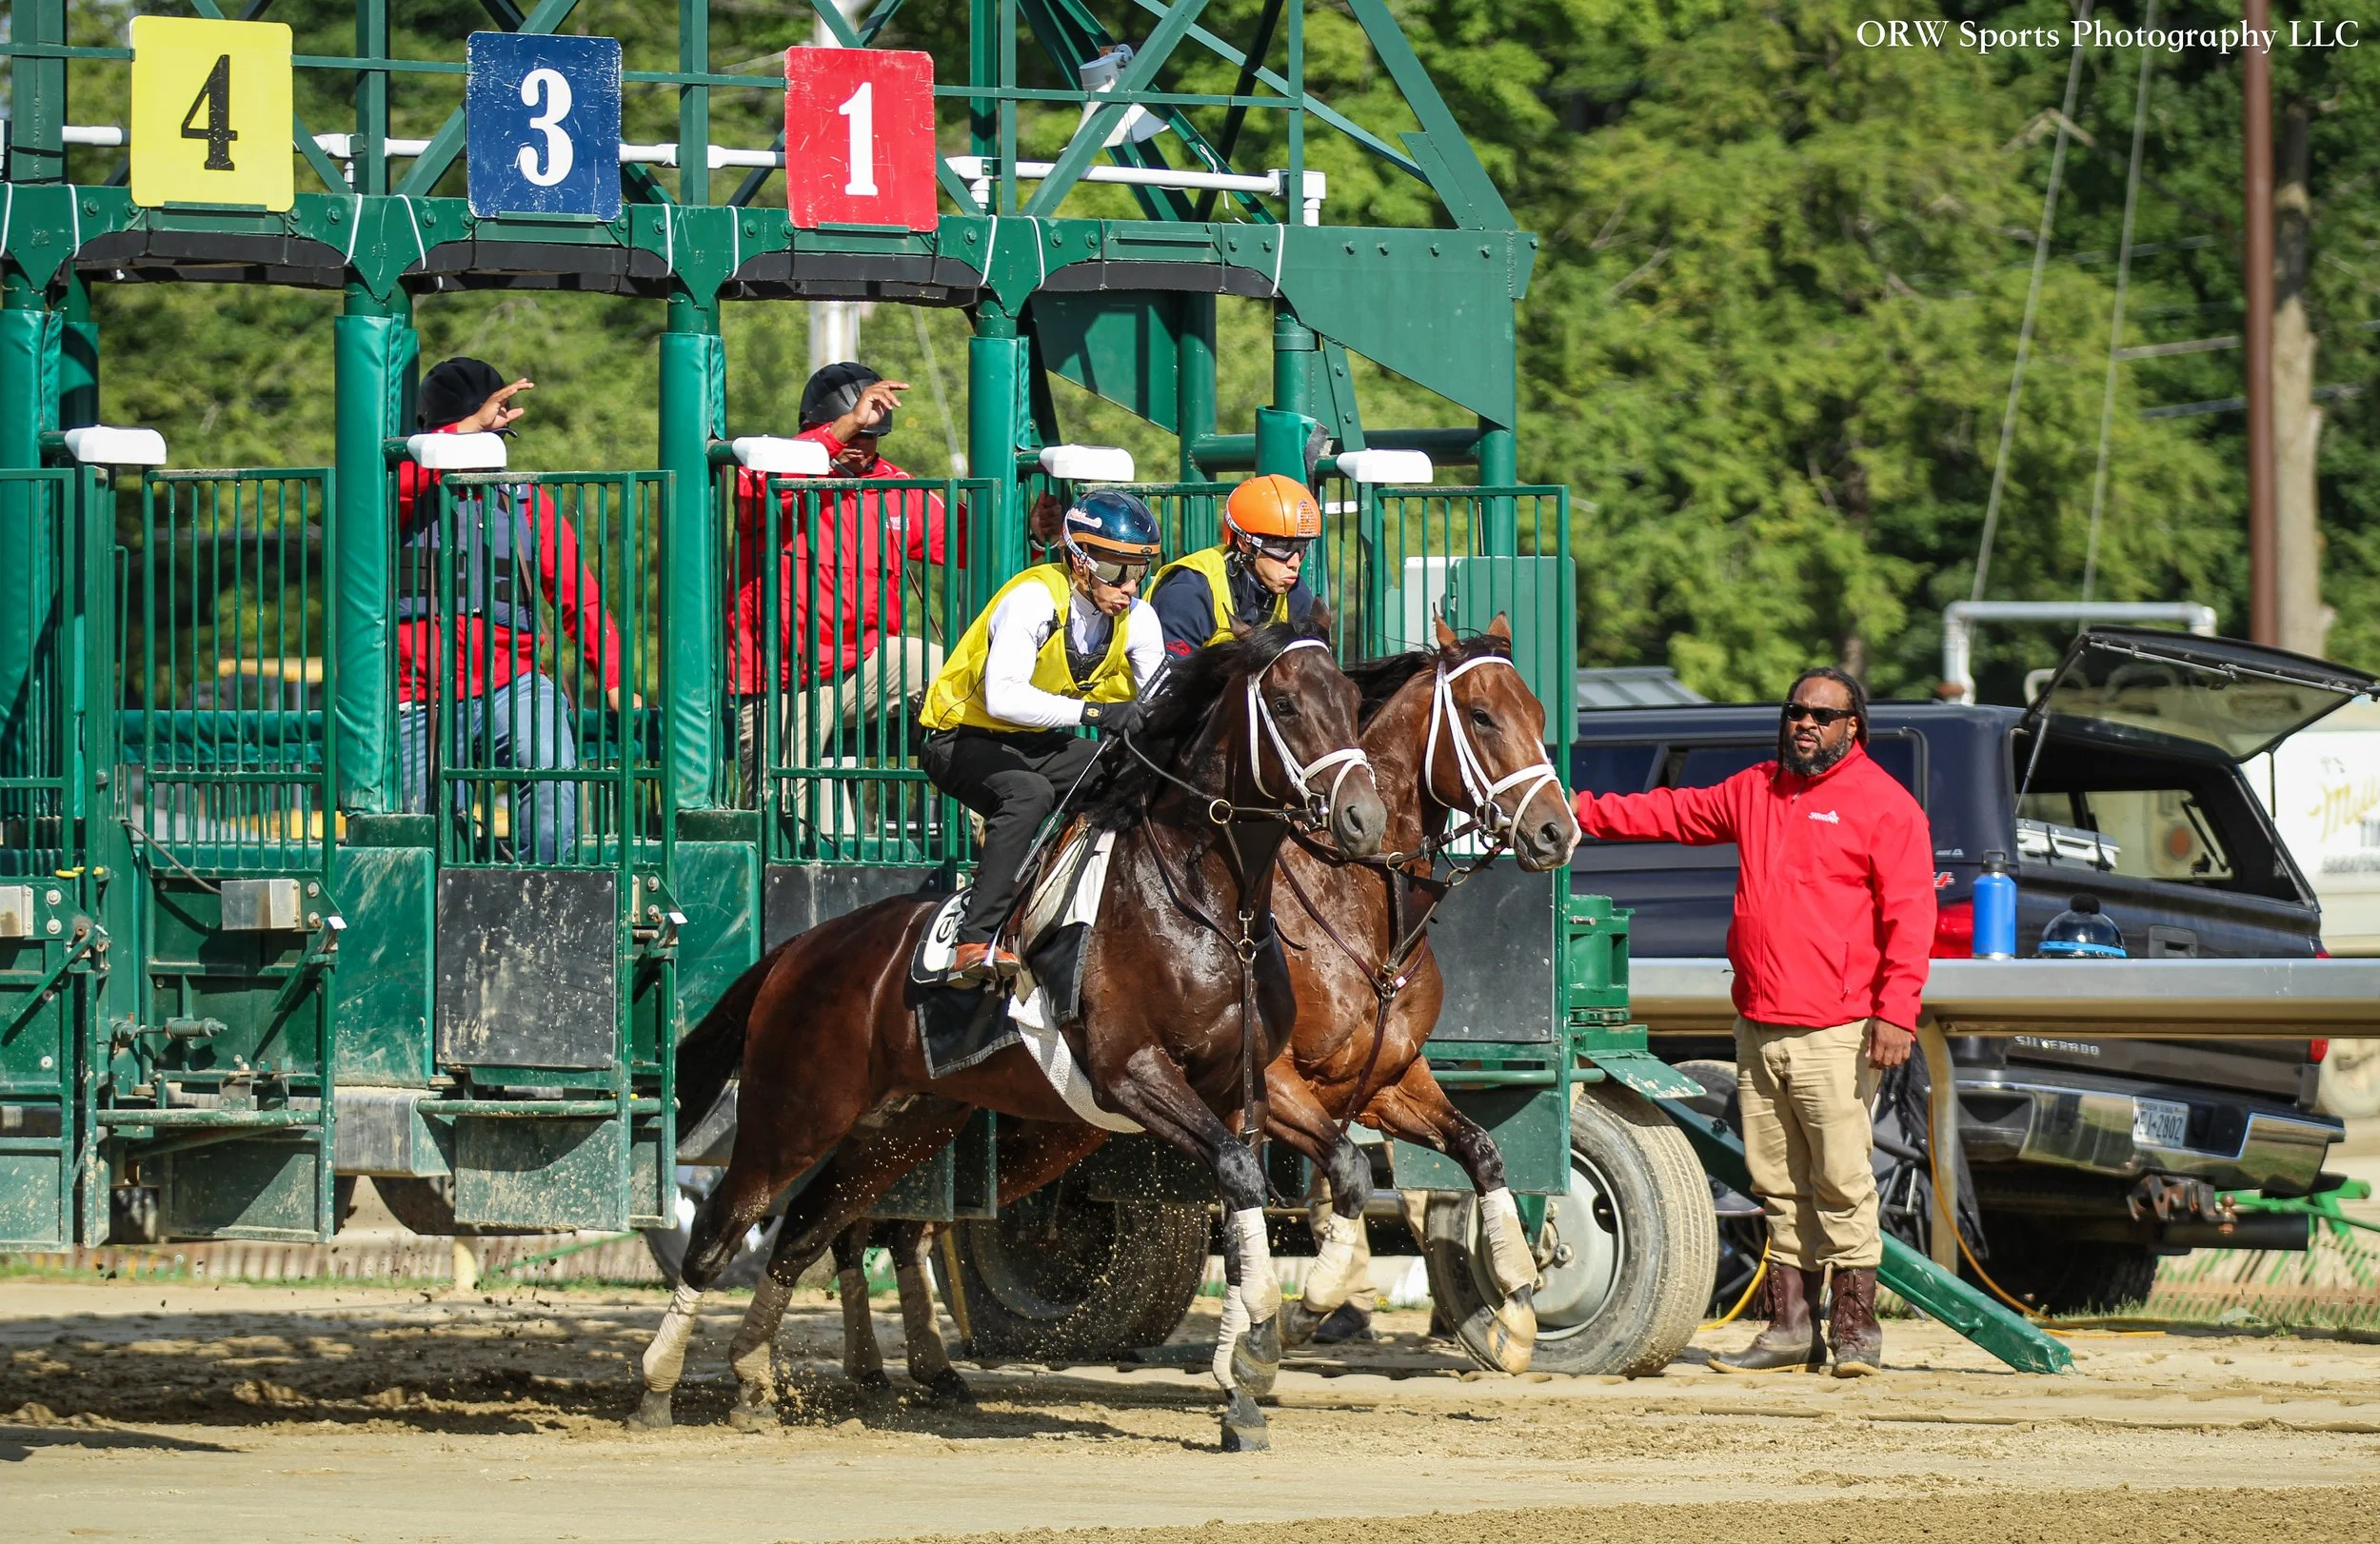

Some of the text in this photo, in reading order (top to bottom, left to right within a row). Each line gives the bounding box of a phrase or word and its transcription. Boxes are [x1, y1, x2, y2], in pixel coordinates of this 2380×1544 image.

[181, 54, 238, 171] 4
[514, 68, 574, 187] 3
[839, 82, 879, 196] 1
